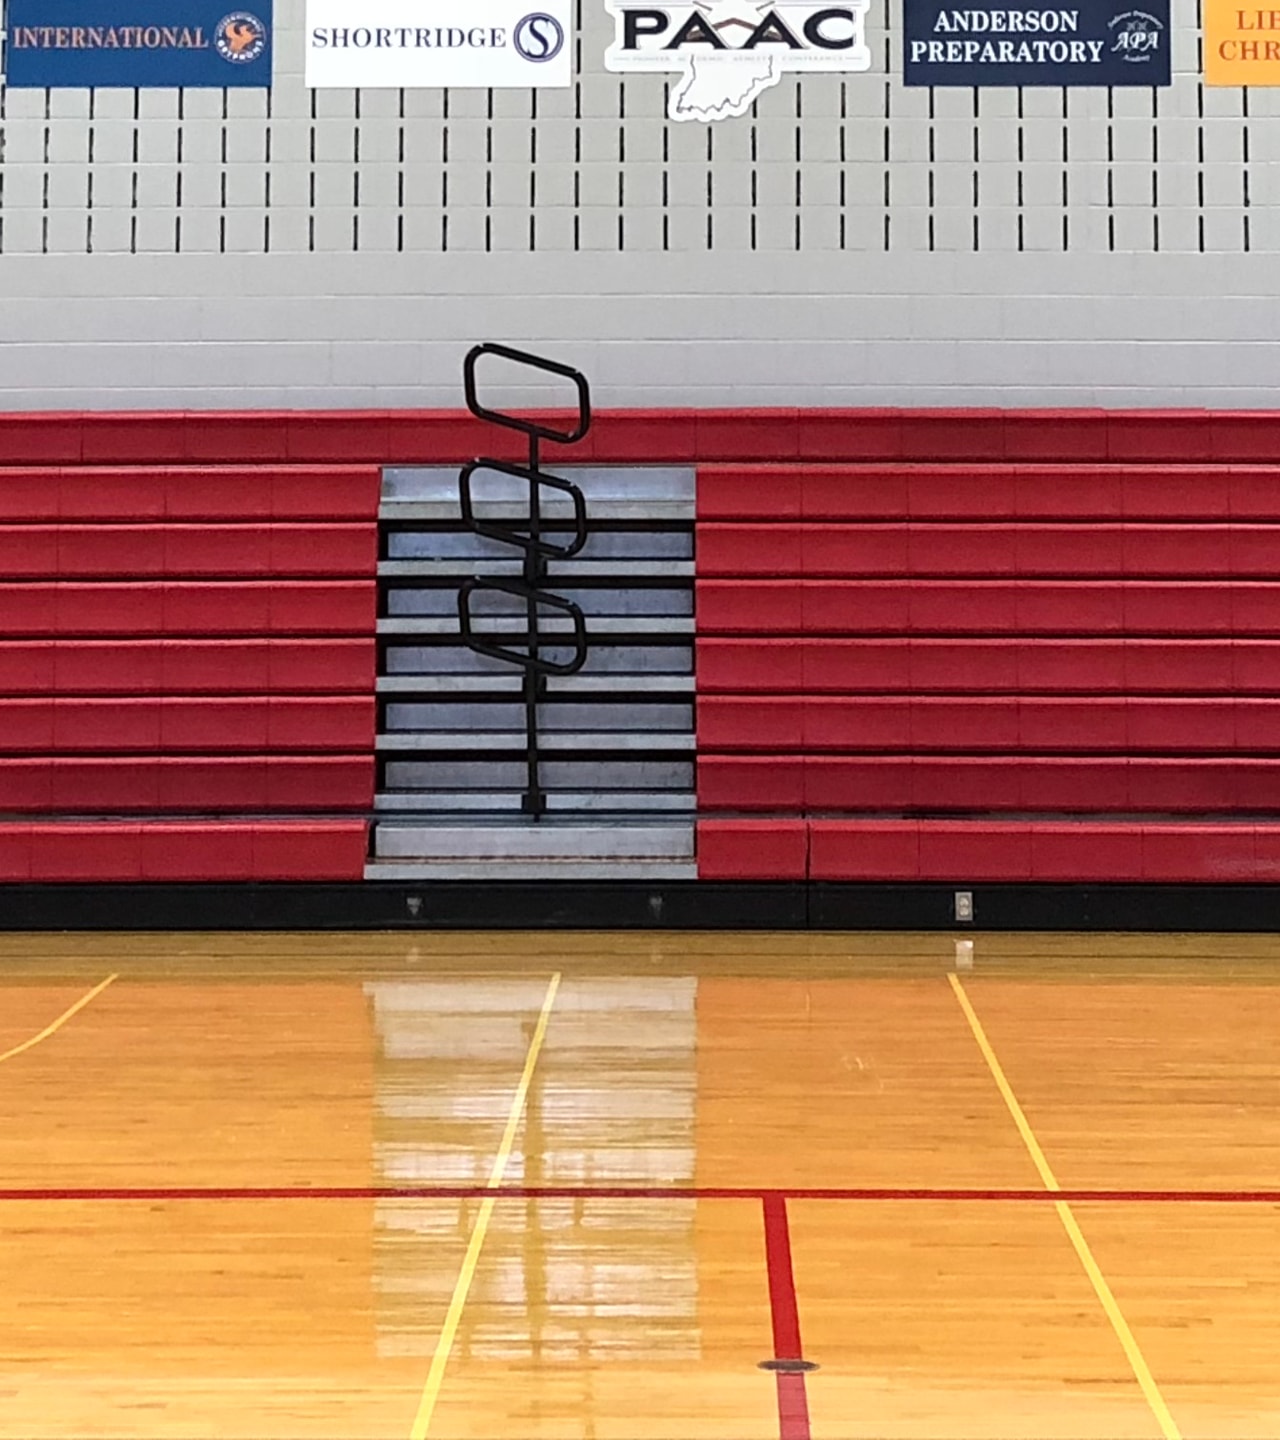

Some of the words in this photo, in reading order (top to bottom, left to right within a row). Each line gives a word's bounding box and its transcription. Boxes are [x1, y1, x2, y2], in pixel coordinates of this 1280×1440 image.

[621, 9, 855, 50] PAAC
[933, 10, 1078, 32] ANDERSON
[13, 26, 208, 49] INTERNATIONAL
[312, 27, 506, 48] SHORTRIDGE
[911, 40, 1104, 63] PREPARATORY
